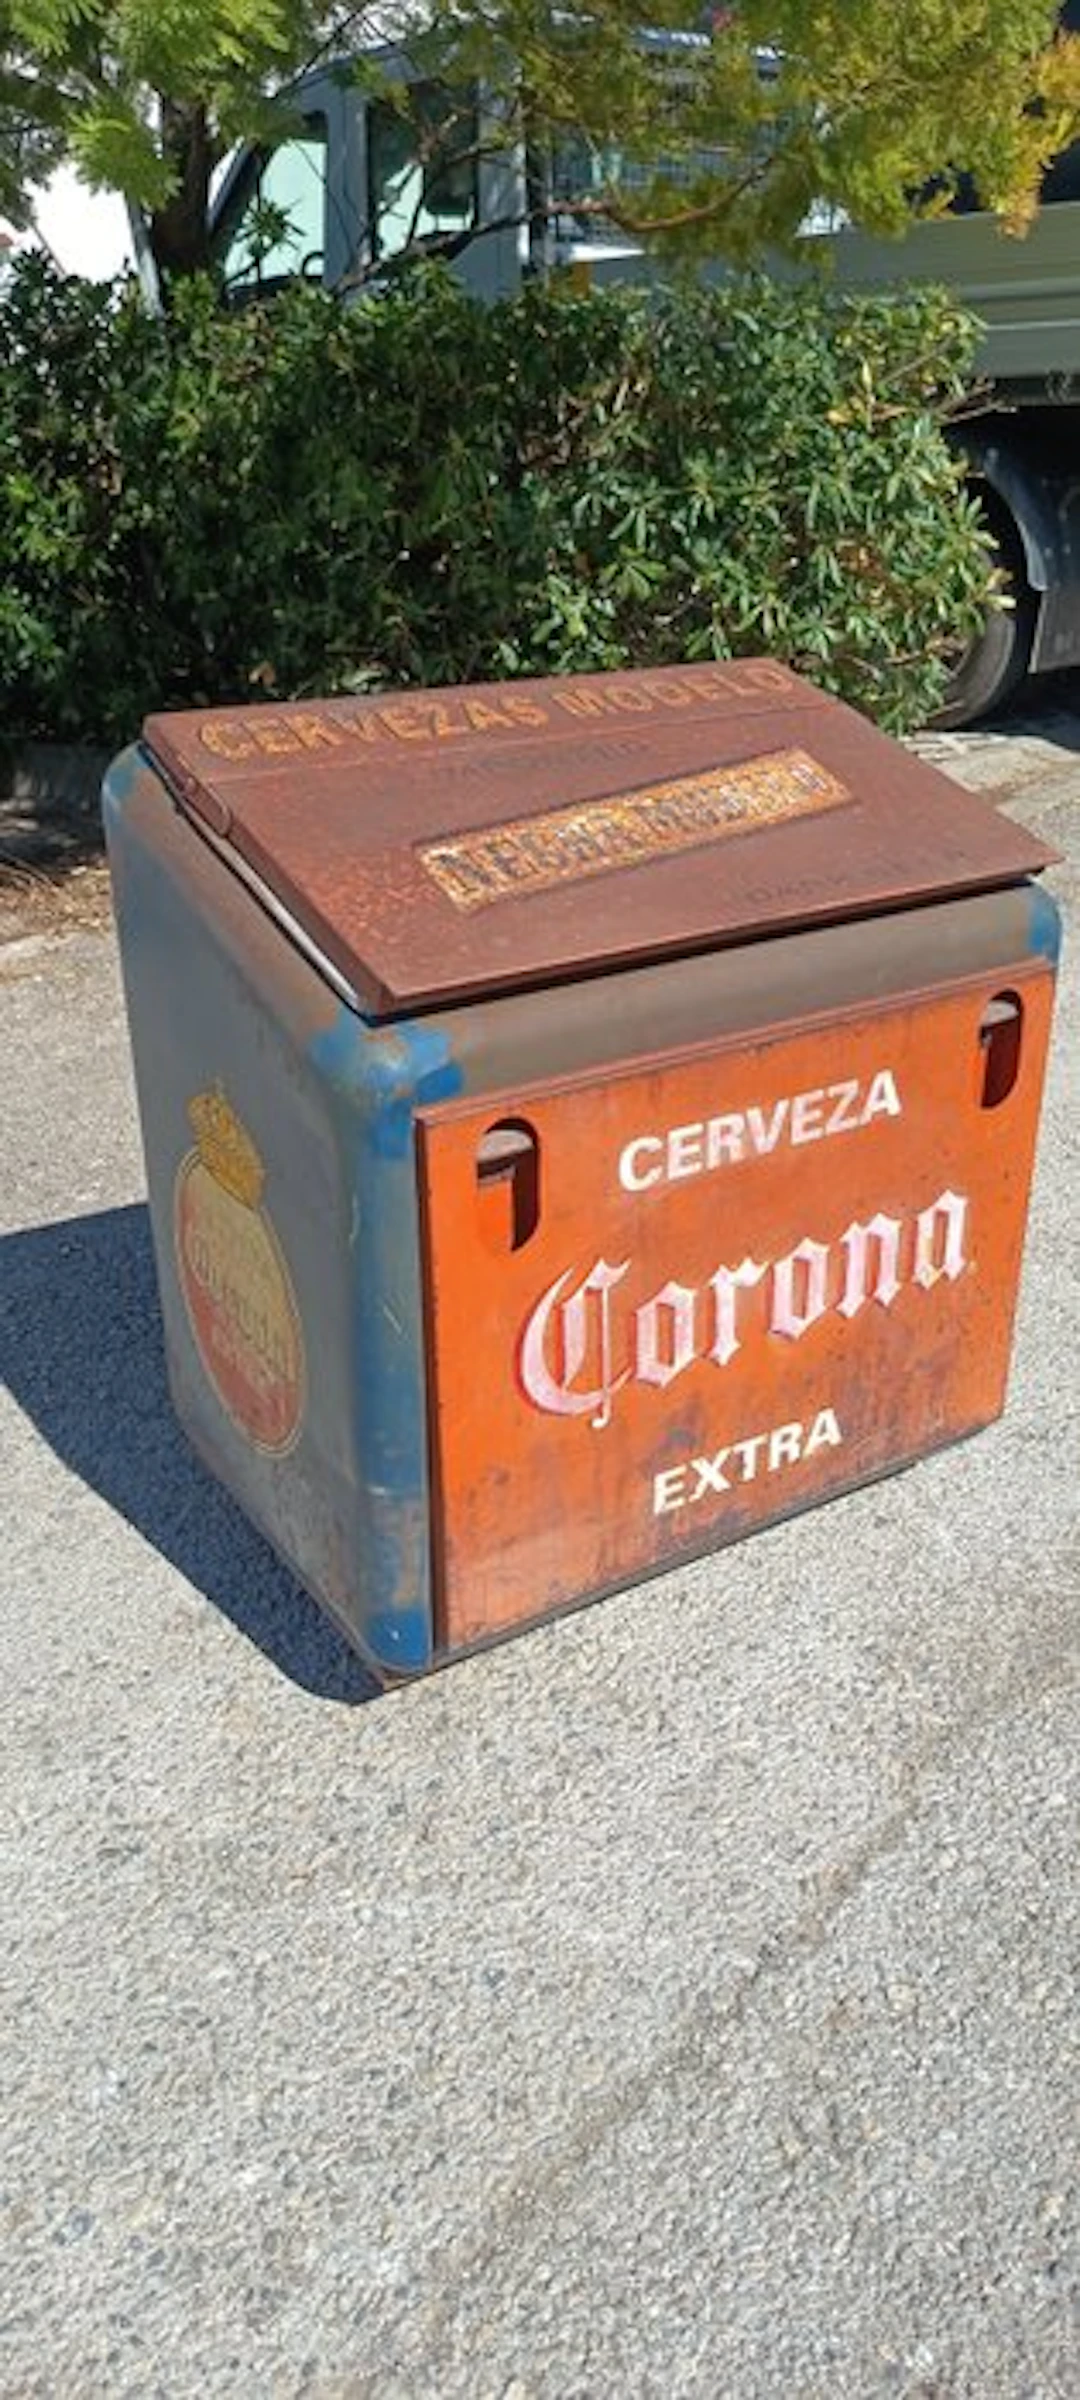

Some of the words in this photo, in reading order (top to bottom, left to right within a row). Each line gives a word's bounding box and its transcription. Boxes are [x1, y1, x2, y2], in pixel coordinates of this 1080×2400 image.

[200, 697, 549, 761] CERVEZAS
[551, 664, 796, 720] MODELO
[618, 1069, 903, 1193] CERVEZA
[515, 1188, 970, 1428] Corona
[652, 1408, 843, 1515] EXTRA
